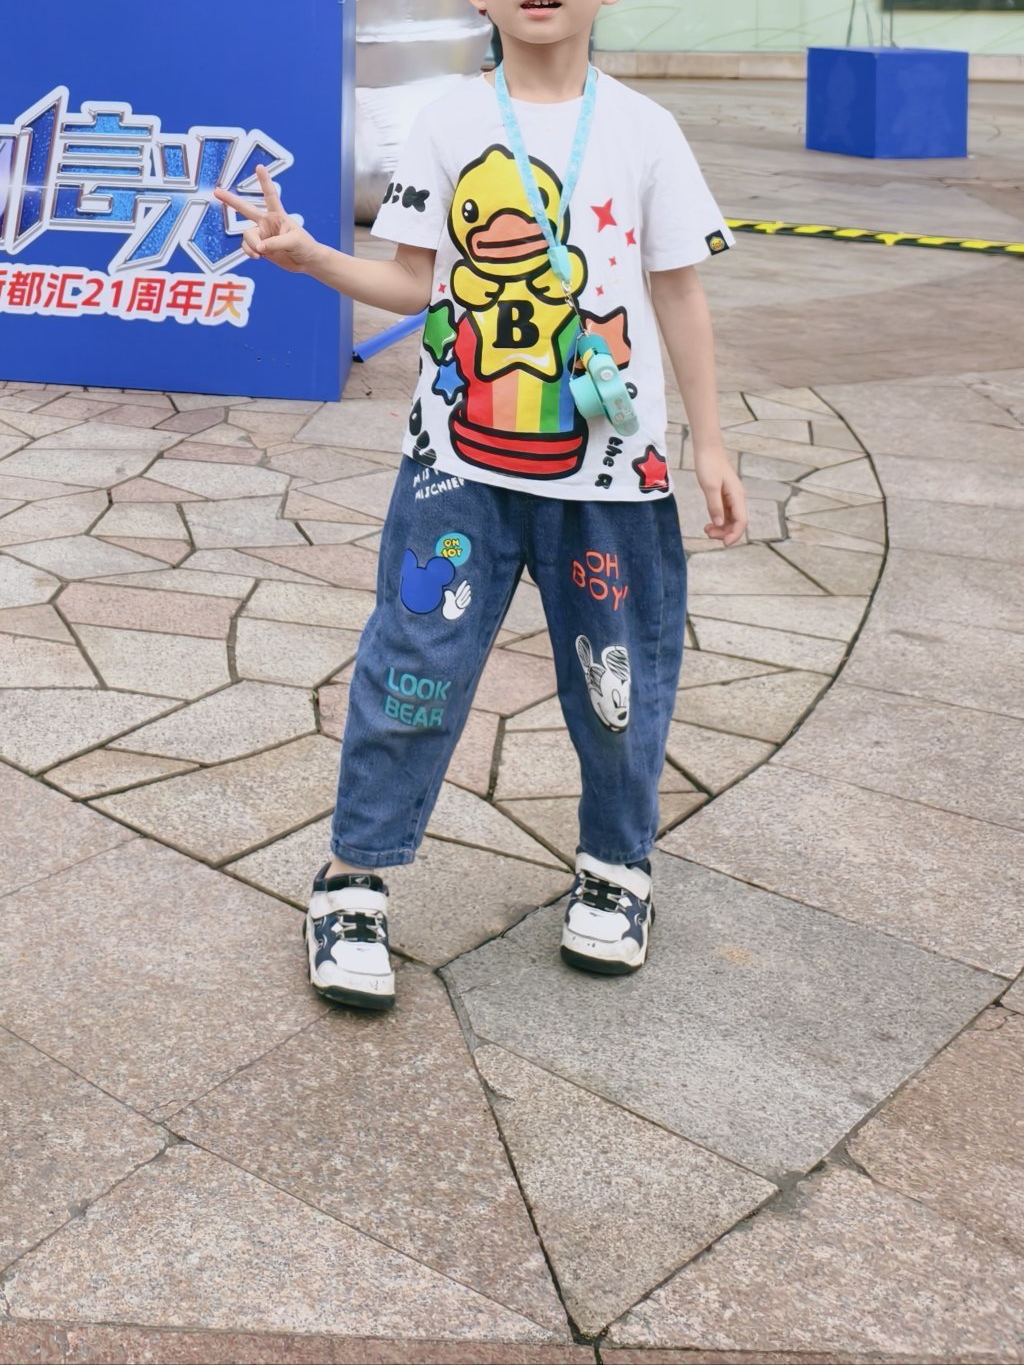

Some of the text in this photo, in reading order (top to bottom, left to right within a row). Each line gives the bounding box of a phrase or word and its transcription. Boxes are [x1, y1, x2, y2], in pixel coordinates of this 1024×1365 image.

[491, 299, 540, 349] B
[585, 550, 619, 579] OH
[387, 666, 452, 701] LOOK
[384, 694, 444, 728] BEAR
